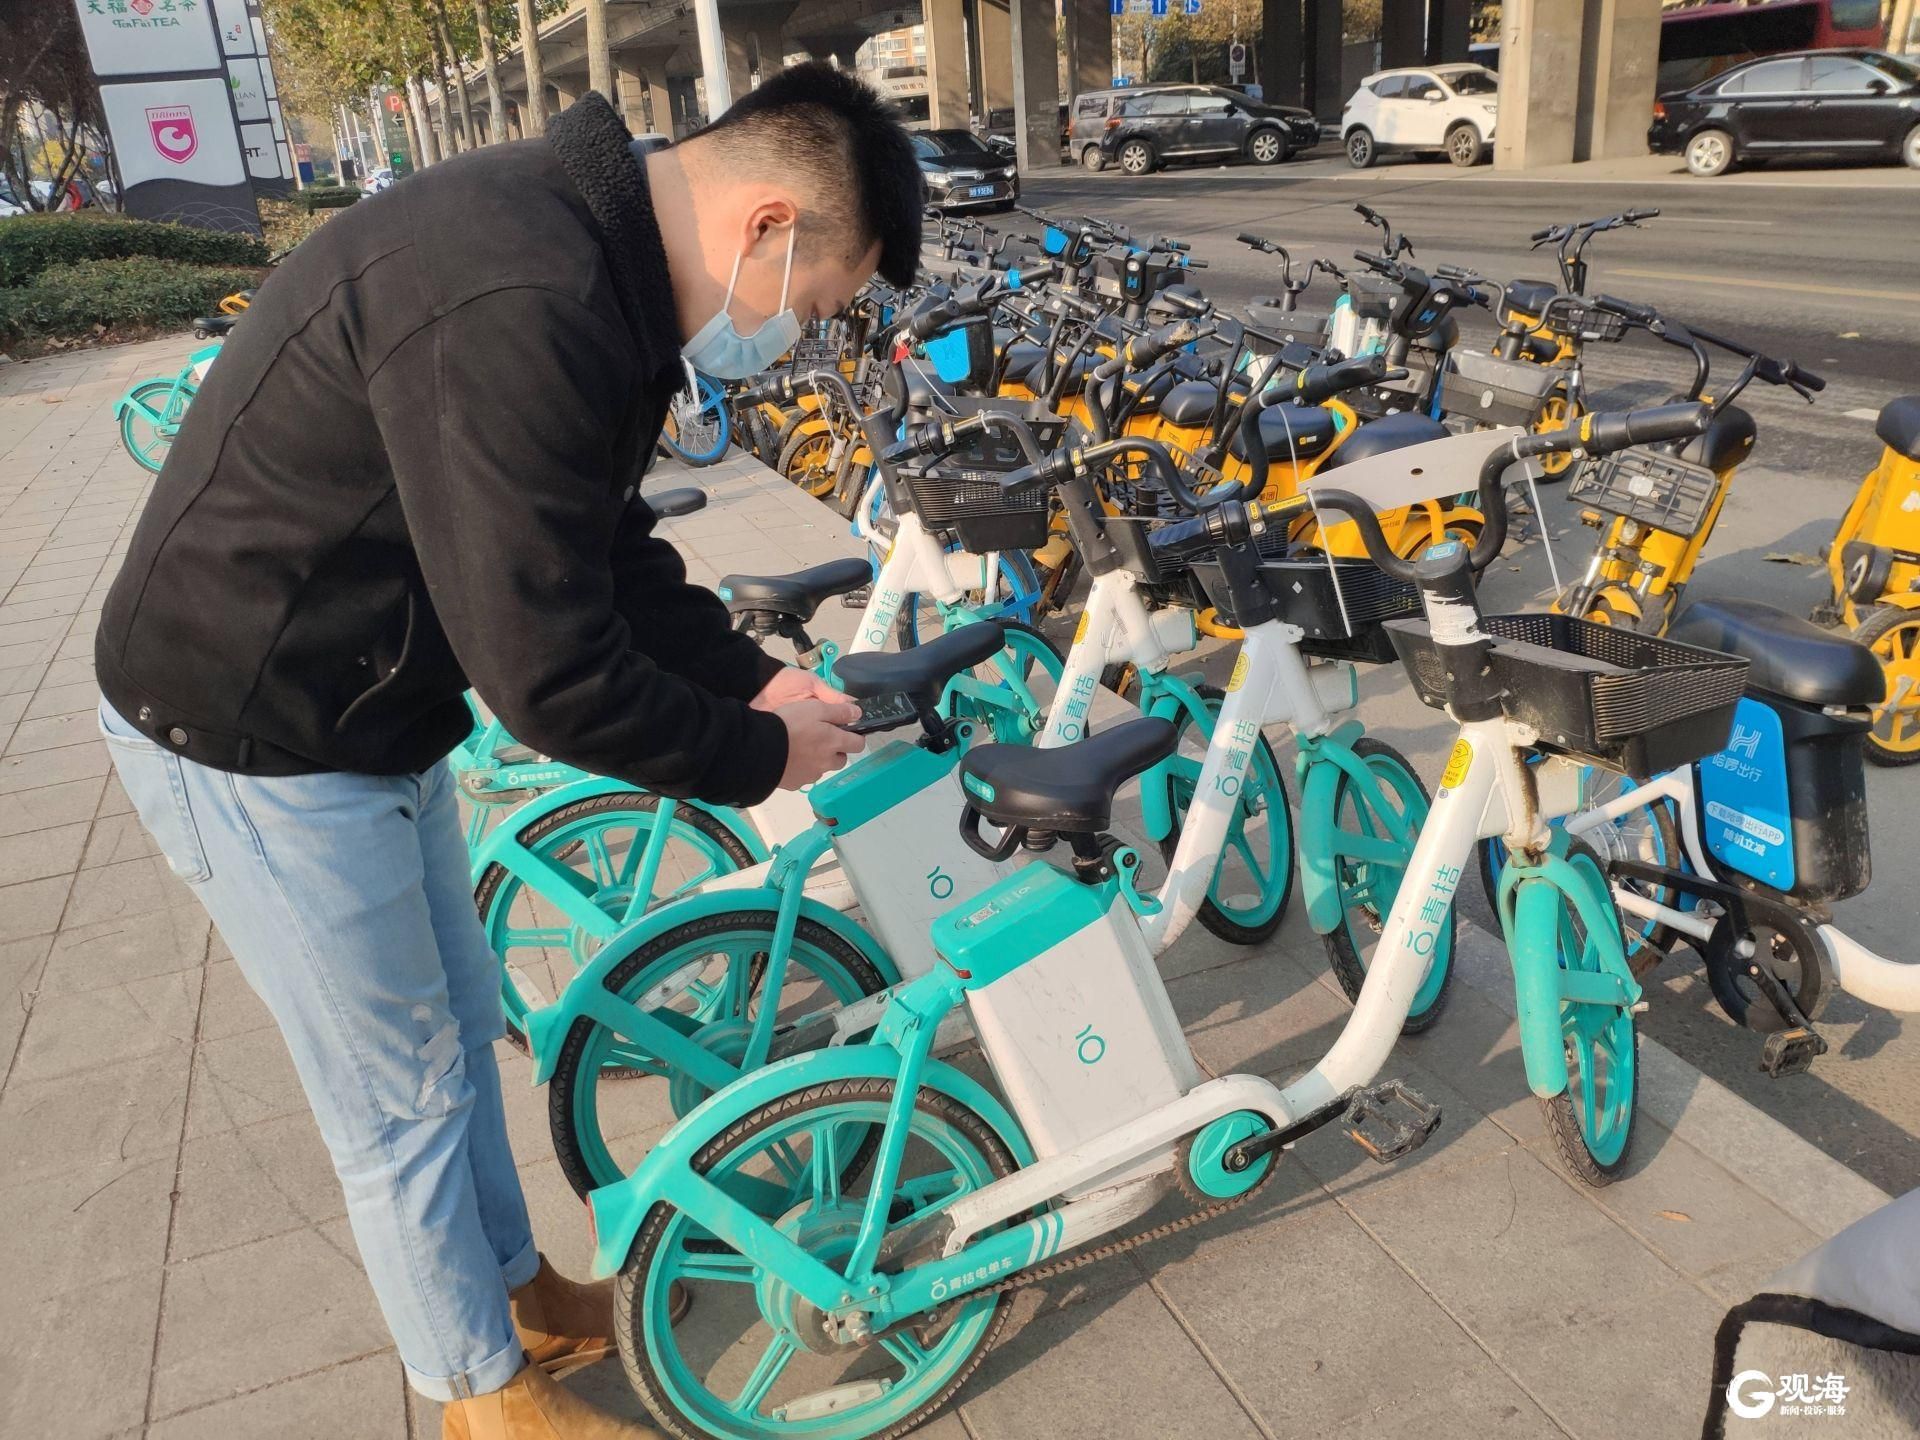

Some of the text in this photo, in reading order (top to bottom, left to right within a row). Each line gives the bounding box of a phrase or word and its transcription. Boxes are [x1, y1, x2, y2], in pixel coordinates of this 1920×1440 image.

[873, 590, 900, 626] 青桔
[1065, 673, 1096, 721] 青桔
[1222, 719, 1257, 771] 青桔
[1419, 863, 1461, 925] 青桔
